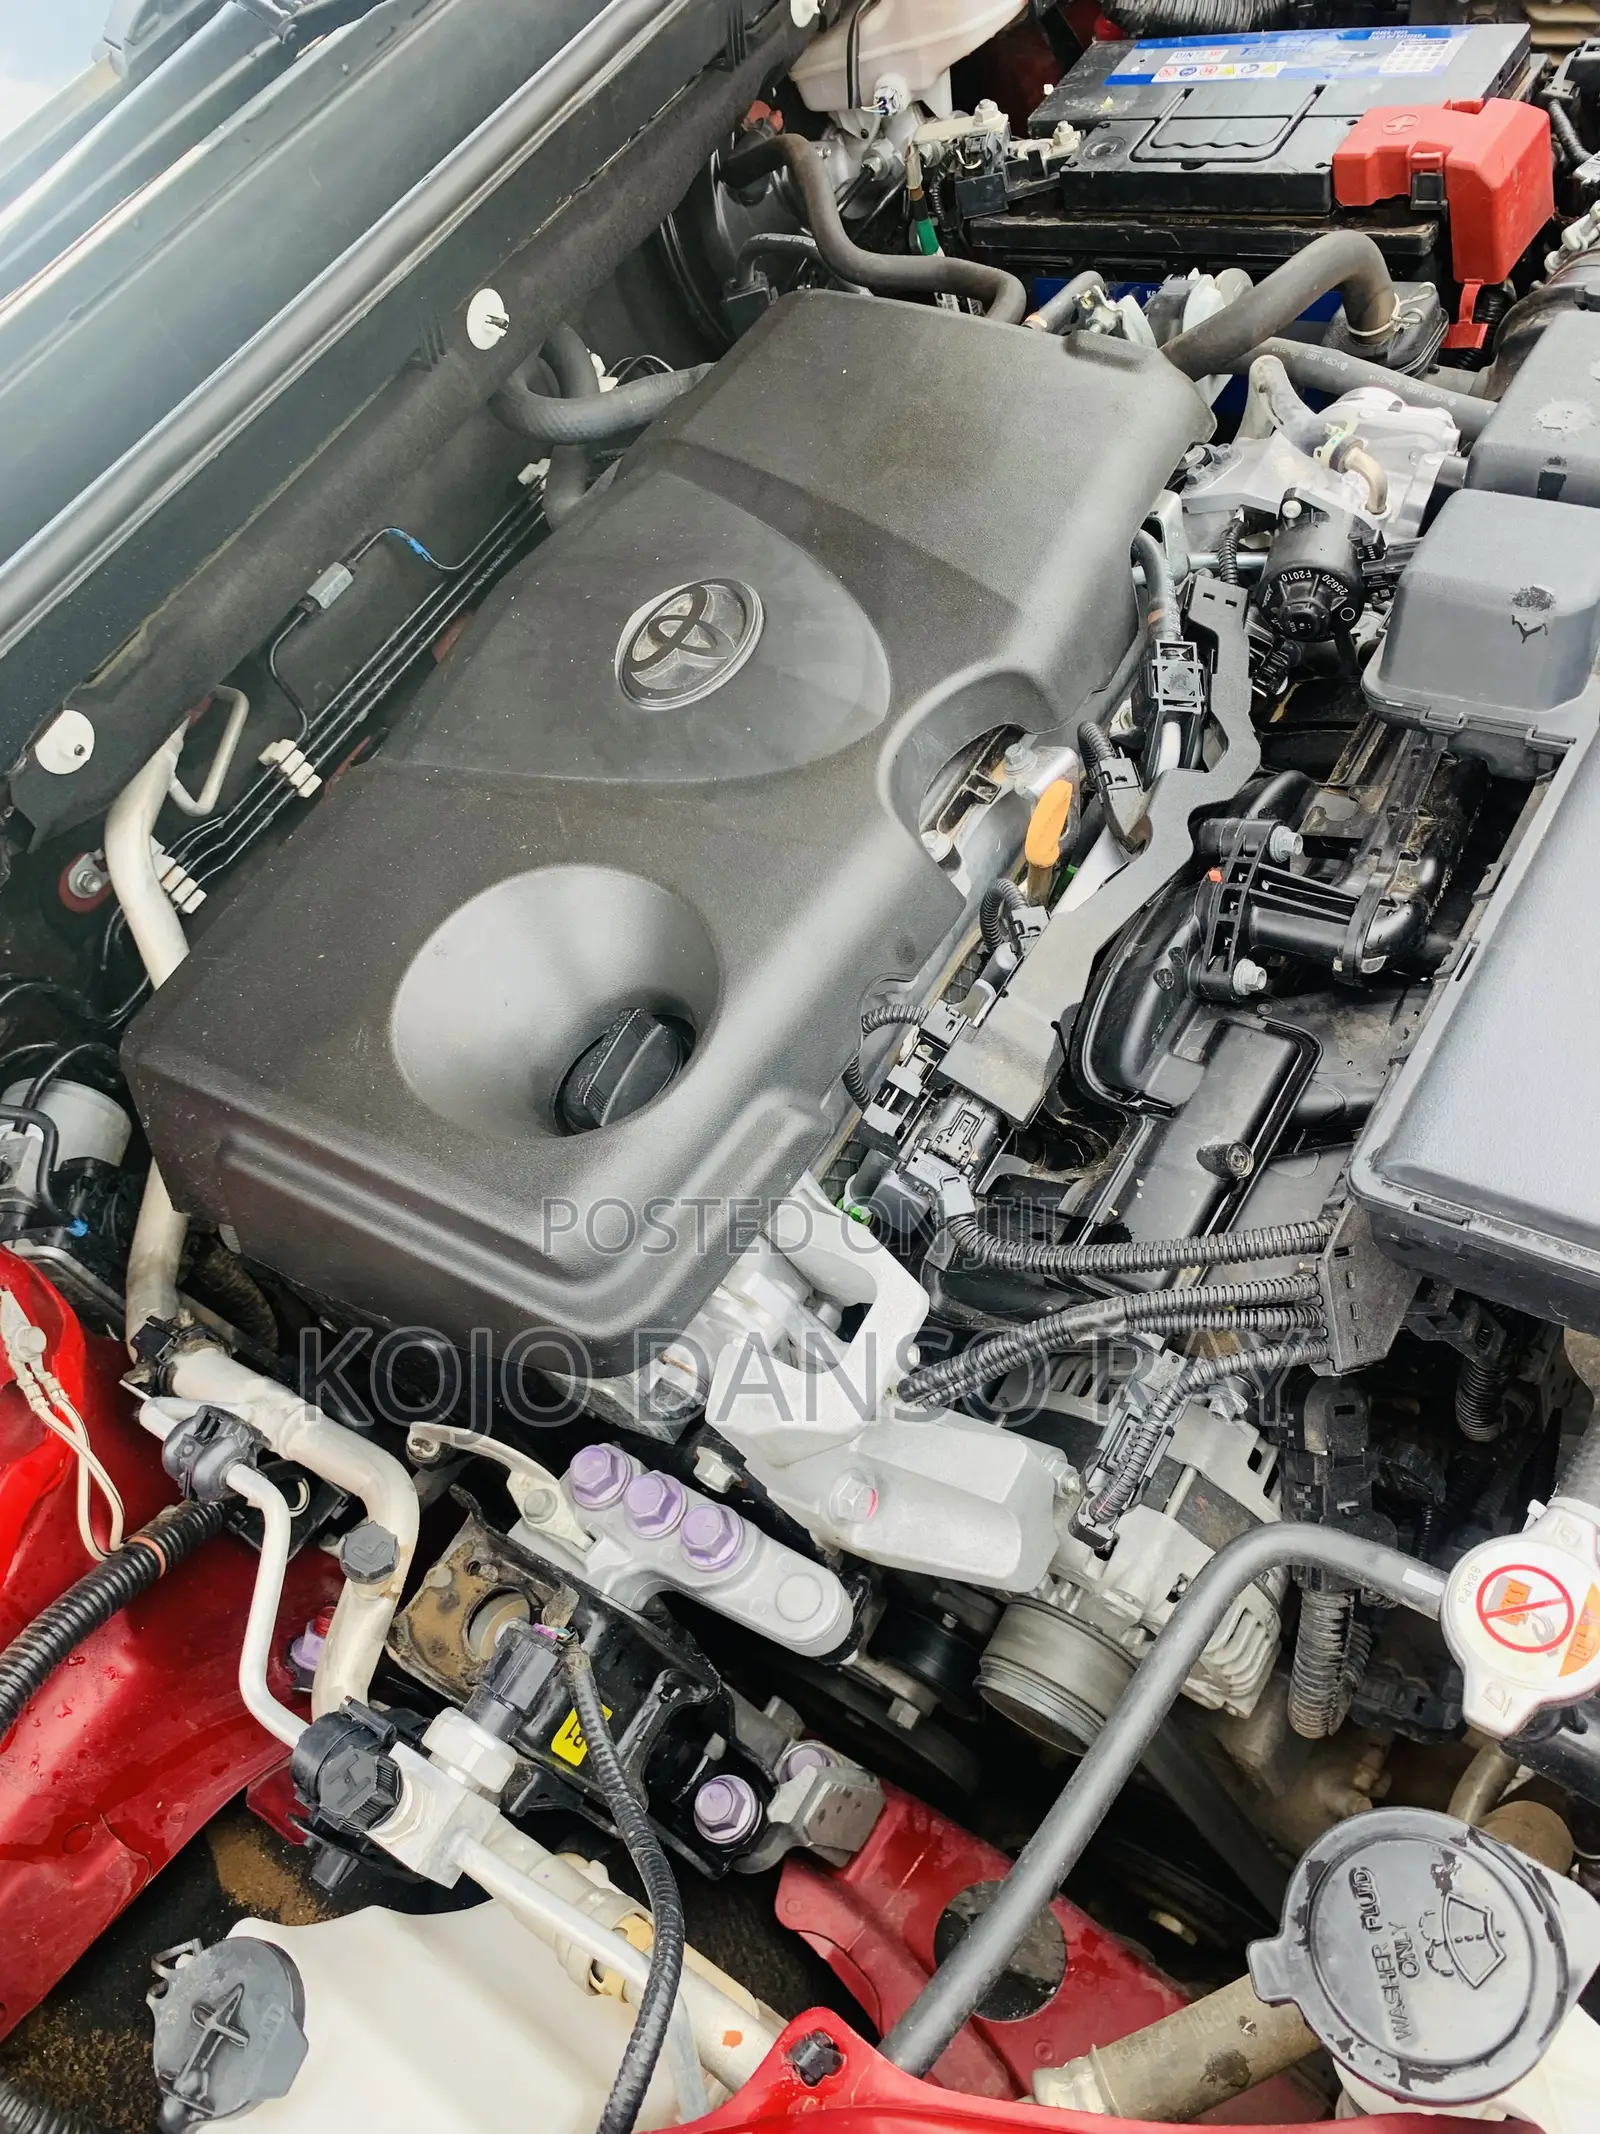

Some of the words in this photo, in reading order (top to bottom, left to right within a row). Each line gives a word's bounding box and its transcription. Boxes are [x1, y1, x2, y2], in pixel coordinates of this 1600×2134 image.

[1281, 569, 1312, 582] F2010
[1321, 574, 1349, 596] 25620
[1457, 1565, 1482, 1605] 88kPa
[1348, 1866, 1384, 1936] FLUID
[1388, 1921, 1421, 1979] ONLY
[1371, 1942, 1413, 2042] WASHER
